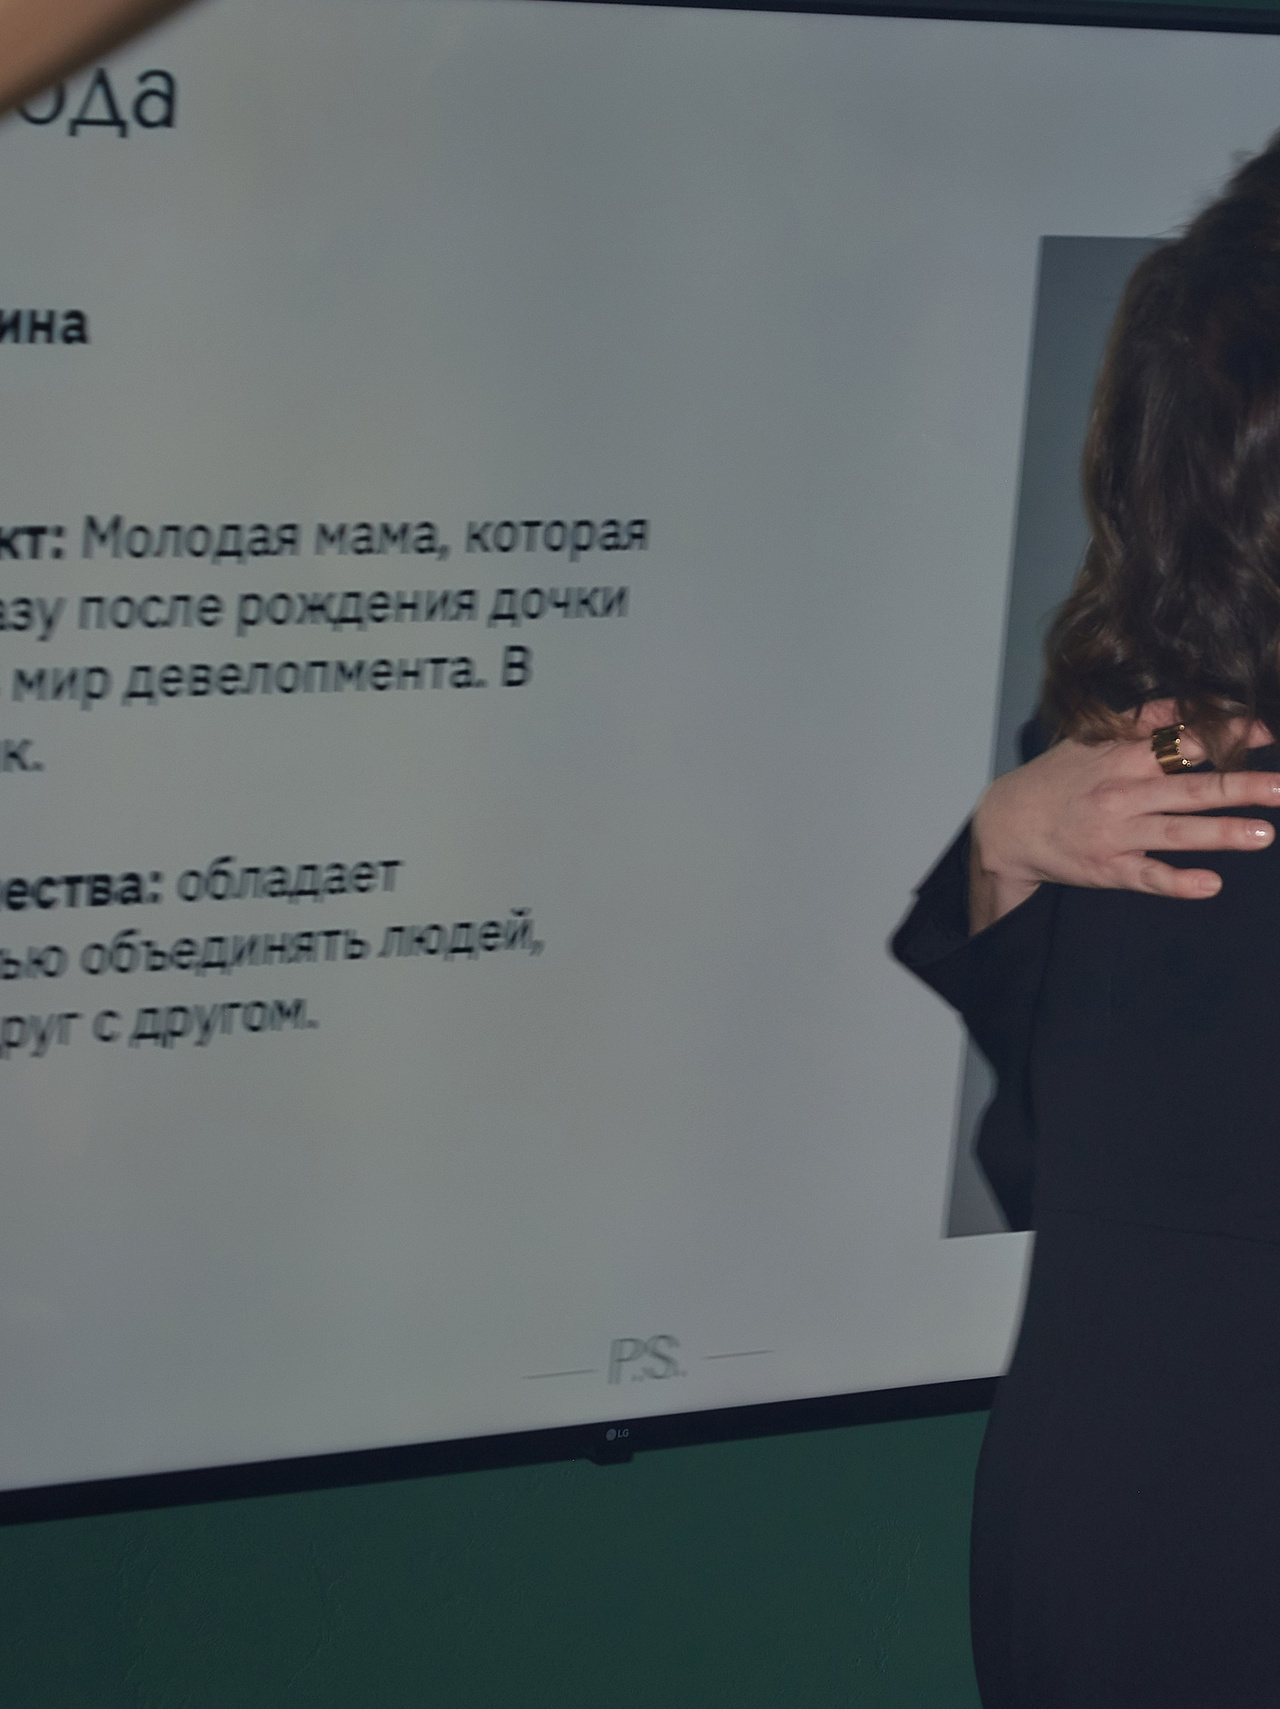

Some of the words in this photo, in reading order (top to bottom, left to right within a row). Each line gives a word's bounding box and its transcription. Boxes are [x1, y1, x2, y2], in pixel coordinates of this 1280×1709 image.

[81, 514, 302, 565] Молодая
[314, 521, 451, 561] мама,
[465, 518, 650, 563] которая
[78, 593, 225, 630] после
[236, 589, 479, 638] рождения
[486, 586, 629, 628] дочки
[12, 665, 113, 709] мир
[121, 656, 488, 705] девелопмента.
[500, 644, 533, 688] В
[176, 855, 405, 905] обладает
[80, 928, 372, 977] объединять
[377, 907, 545, 962] людей,
[92, 1009, 122, 1043] с
[128, 998, 319, 1049] другом.
[617, 1429, 629, 1438] LG
